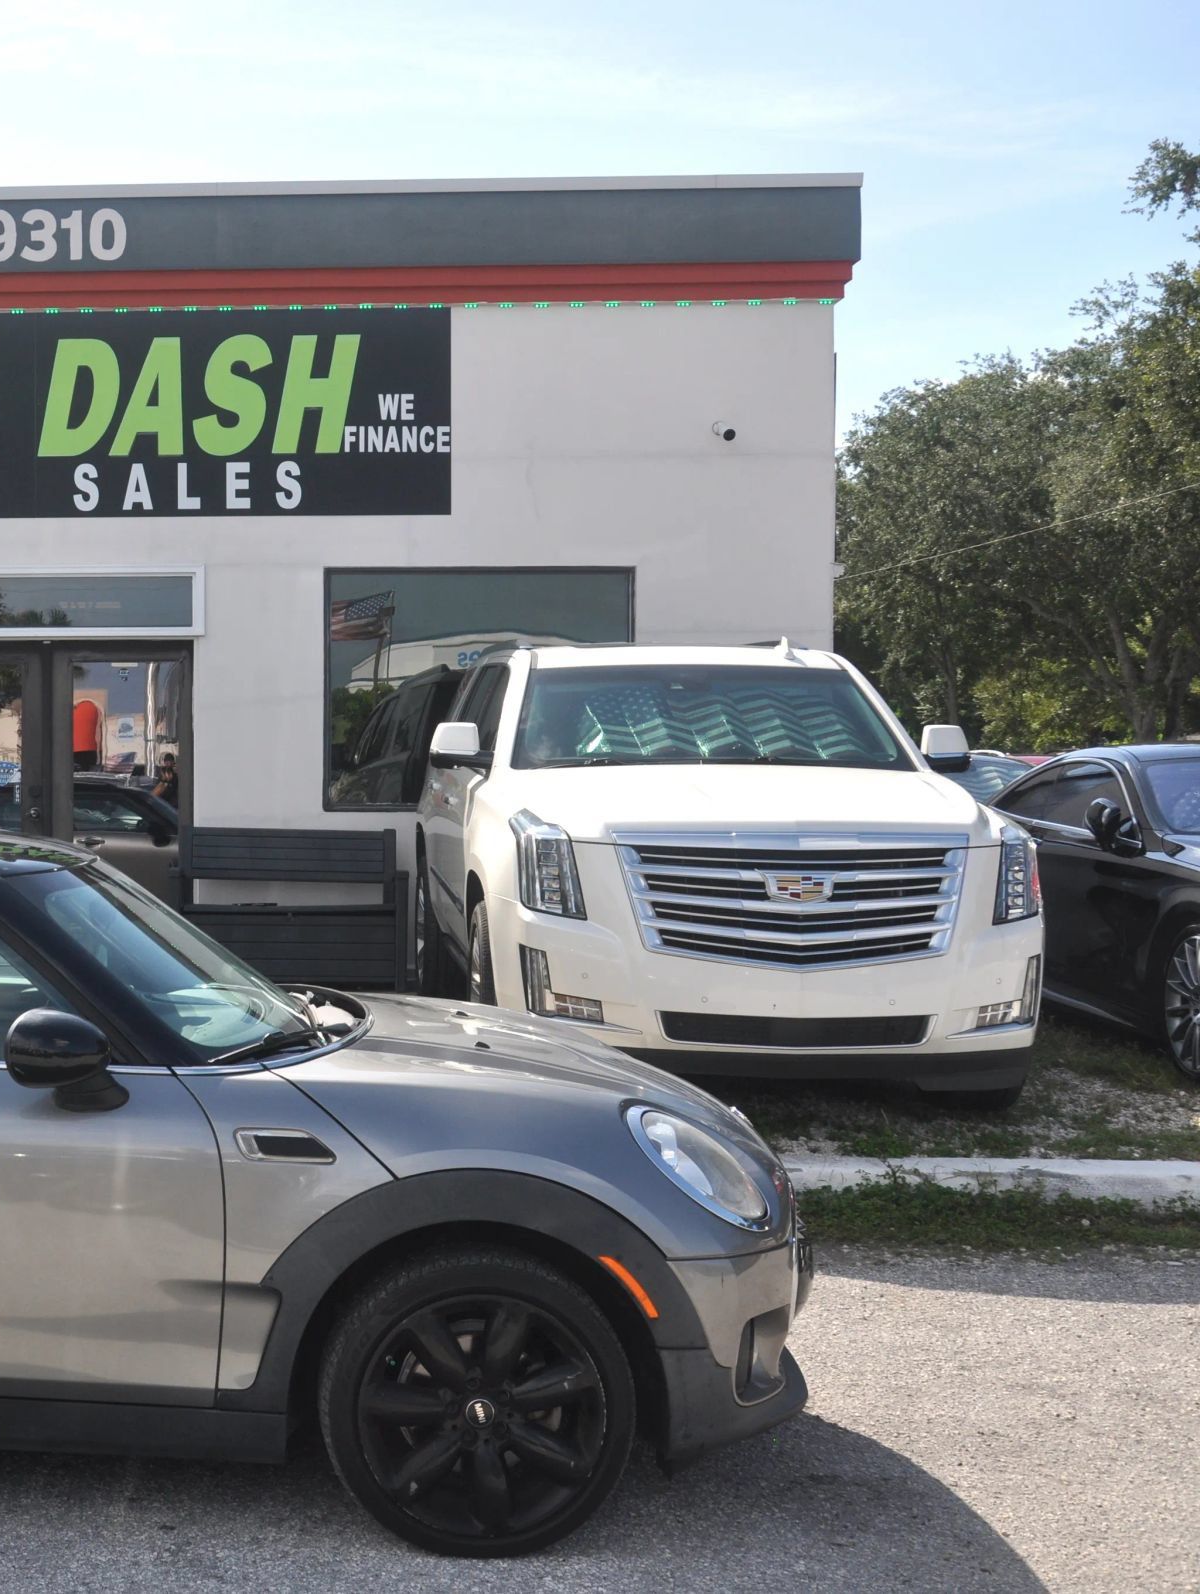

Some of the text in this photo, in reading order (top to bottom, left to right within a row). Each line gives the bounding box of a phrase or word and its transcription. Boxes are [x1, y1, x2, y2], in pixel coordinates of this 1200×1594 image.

[38, 334, 361, 458] DASH
[377, 393, 416, 421] WE
[344, 425, 451, 454] FINANCE
[72, 462, 303, 512] SALES
[474, 1402, 487, 1424] MINI
